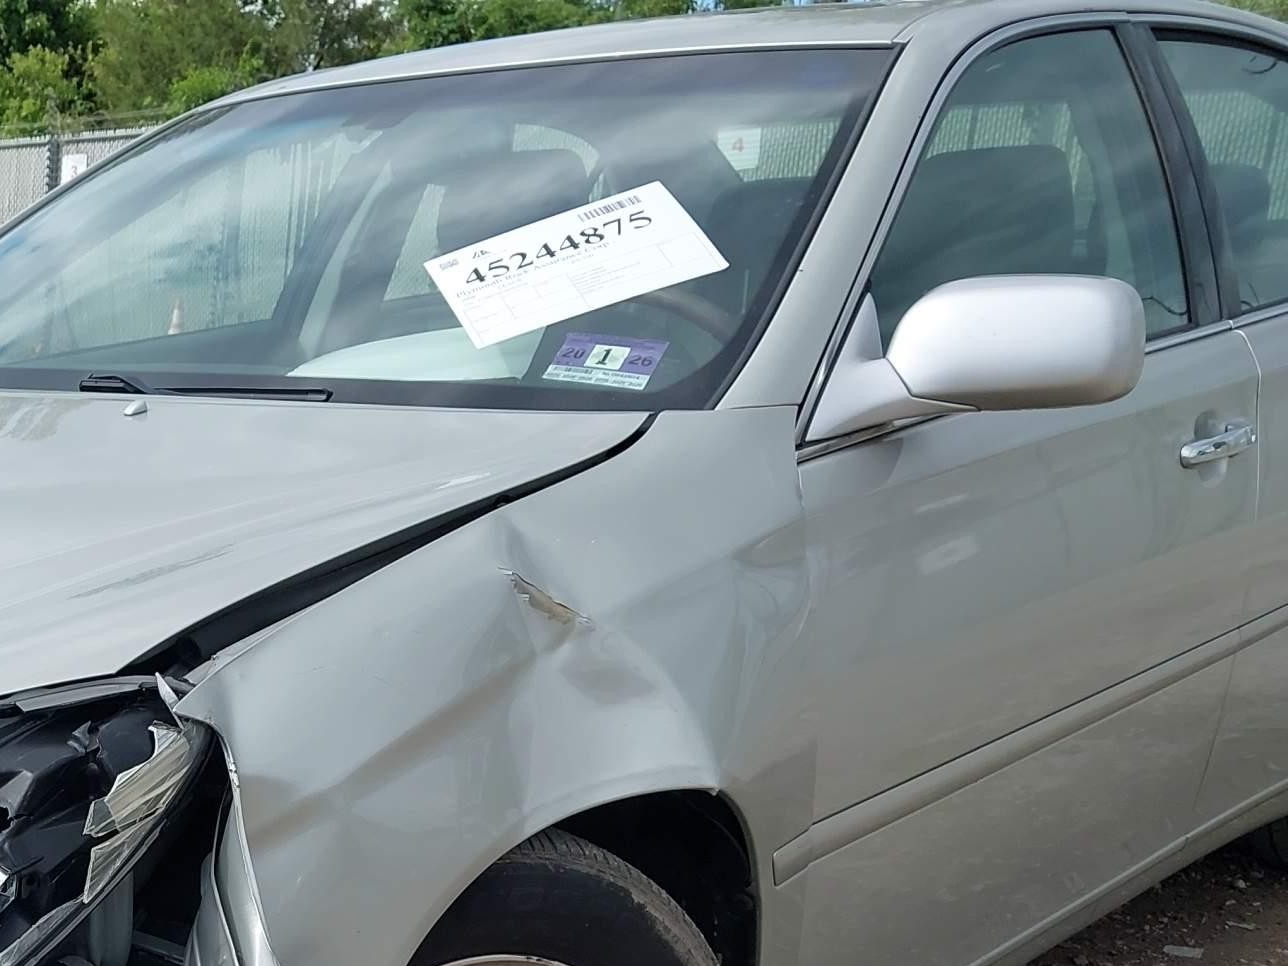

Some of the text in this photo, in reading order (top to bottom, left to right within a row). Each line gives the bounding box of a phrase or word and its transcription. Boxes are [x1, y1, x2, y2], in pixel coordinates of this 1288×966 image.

[732, 137, 744, 152] 4
[466, 210, 652, 284] 45244875
[561, 346, 653, 367] 20 1 26
